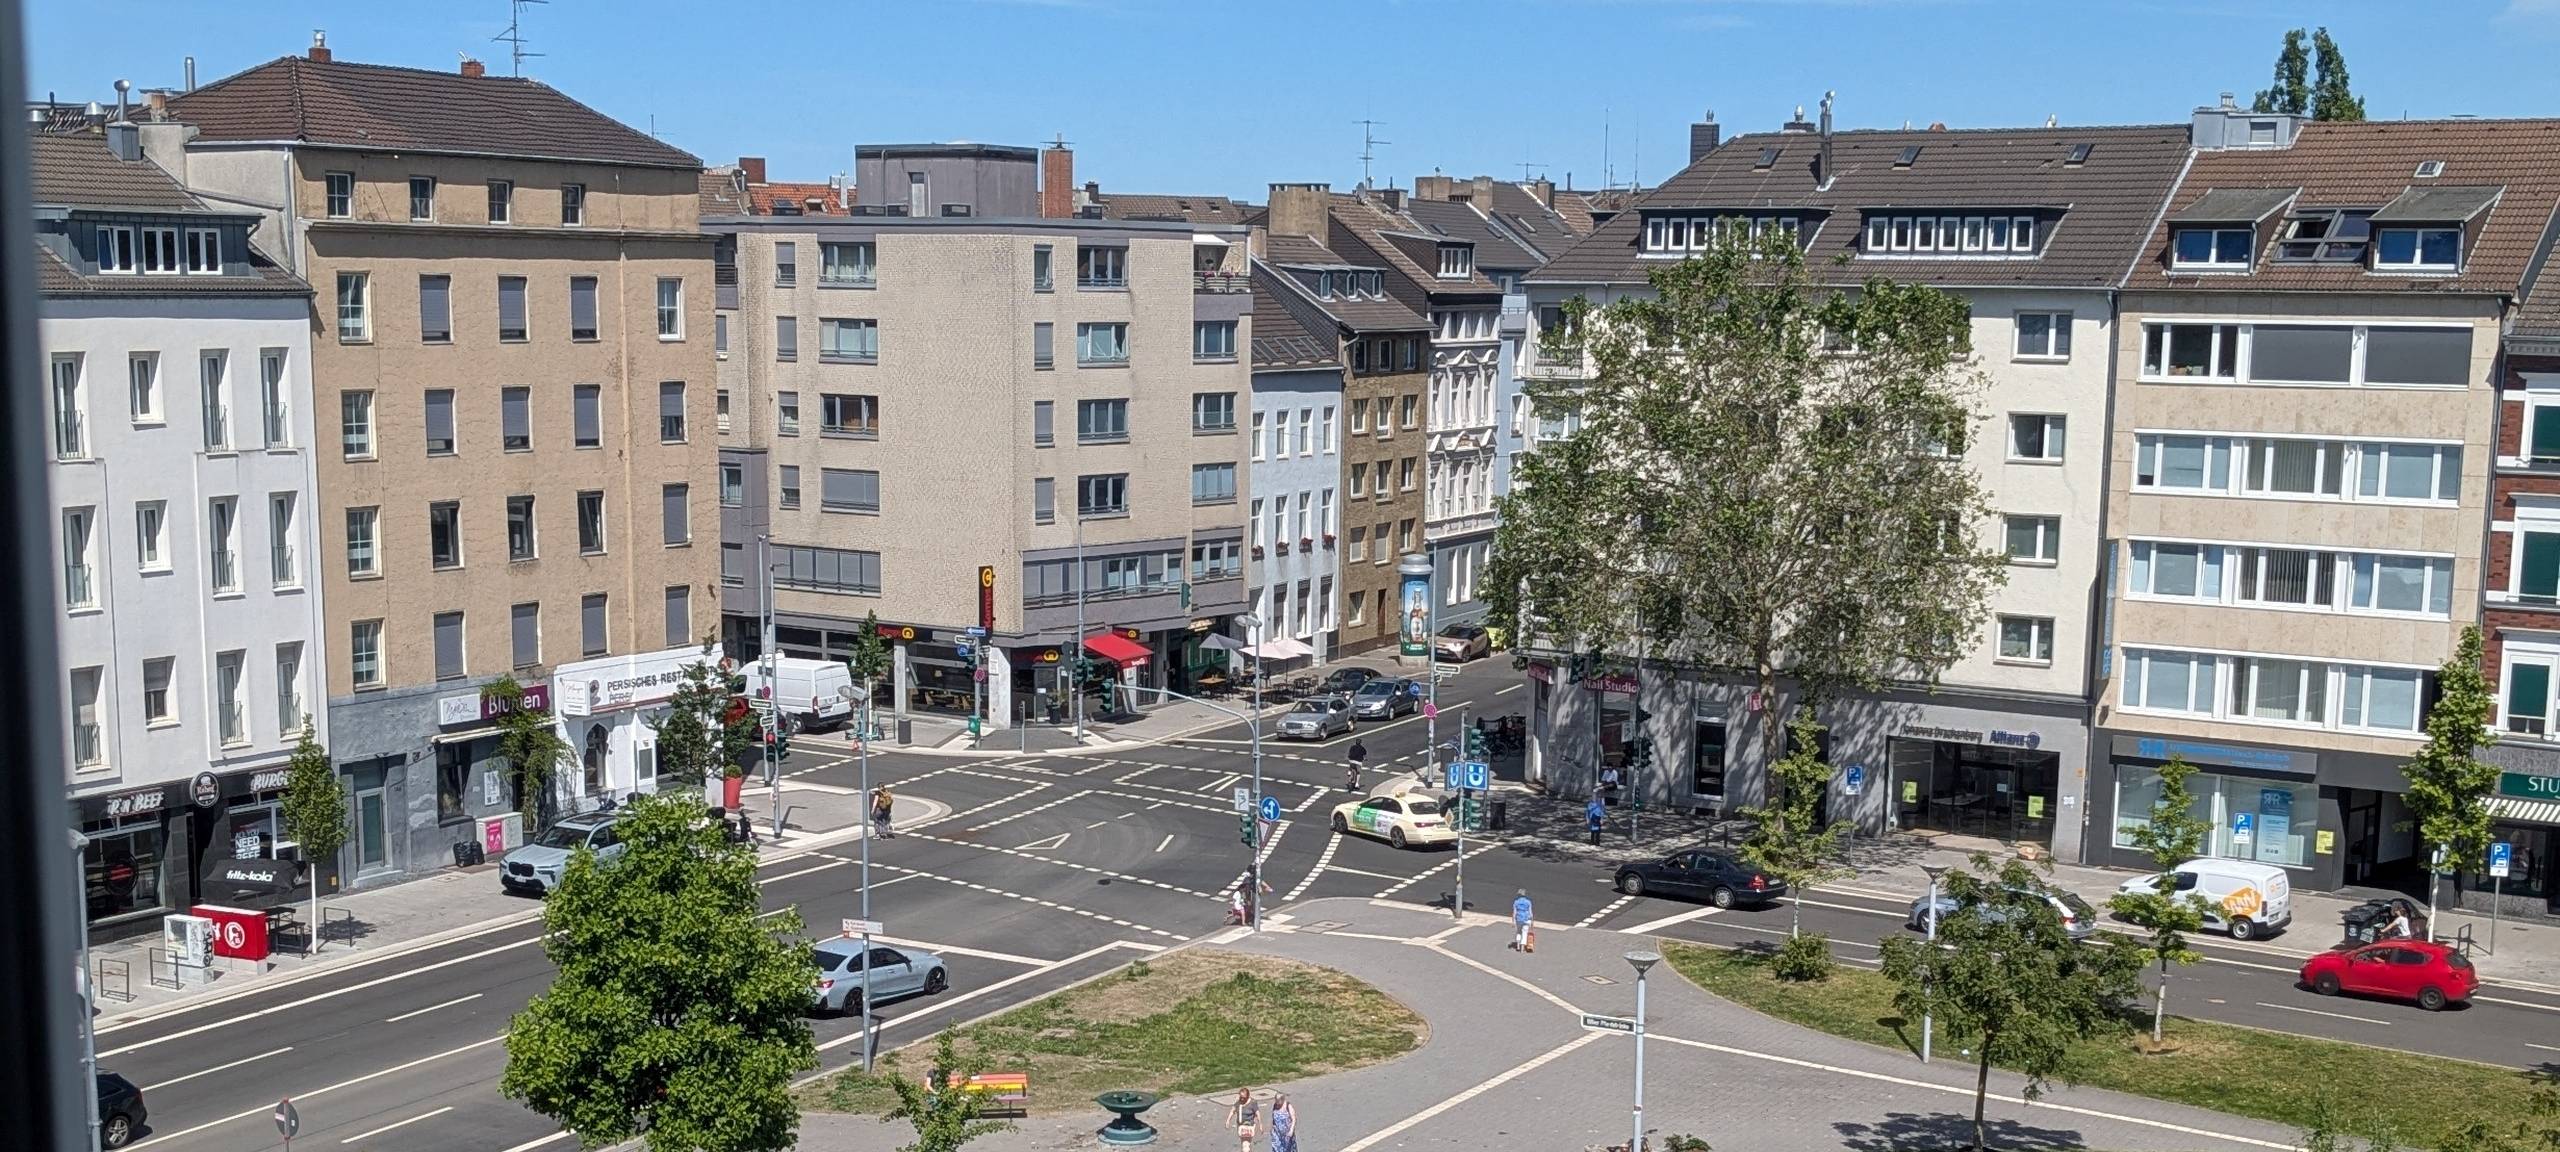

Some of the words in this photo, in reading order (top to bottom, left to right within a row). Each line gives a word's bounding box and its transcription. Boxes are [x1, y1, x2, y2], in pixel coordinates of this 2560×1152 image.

[607, 675, 657, 692] PERSISCHES
[1584, 679, 1604, 690] Nail
[1605, 681, 1637, 693] Studio
[489, 694, 540, 714] Bluen
[1989, 730, 2025, 746] Allianz
[251, 770, 290, 791] BURGE
[235, 836, 260, 849] NEED
[2494, 845, 2503, 856] P
